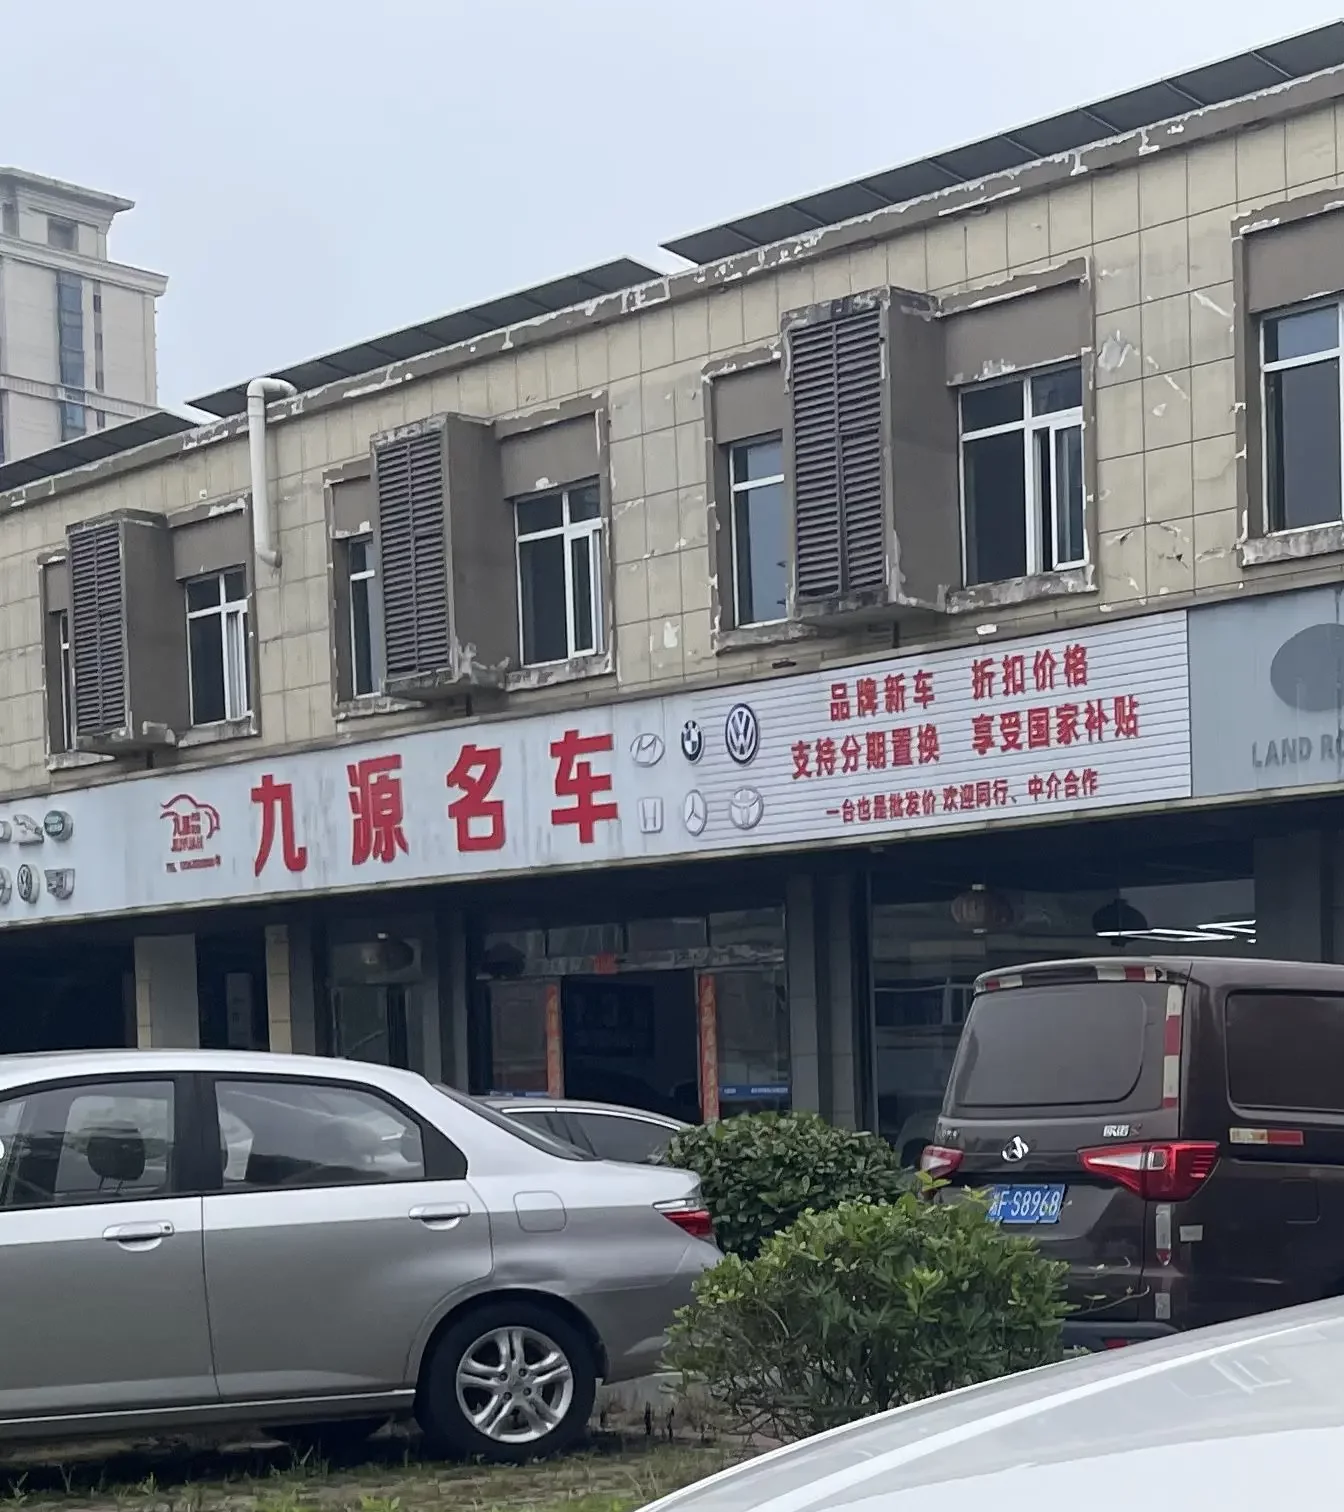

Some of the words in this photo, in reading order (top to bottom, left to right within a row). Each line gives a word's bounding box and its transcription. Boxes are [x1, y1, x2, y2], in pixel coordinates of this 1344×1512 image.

[830, 669, 936, 722] 品牌新车
[971, 643, 1089, 701] 折扣价格
[790, 723, 940, 780] 支持分期置换
[971, 694, 1140, 756] 享受国家补贴
[1252, 735, 1314, 769] LAND
[251, 729, 619, 877] 九源名车
